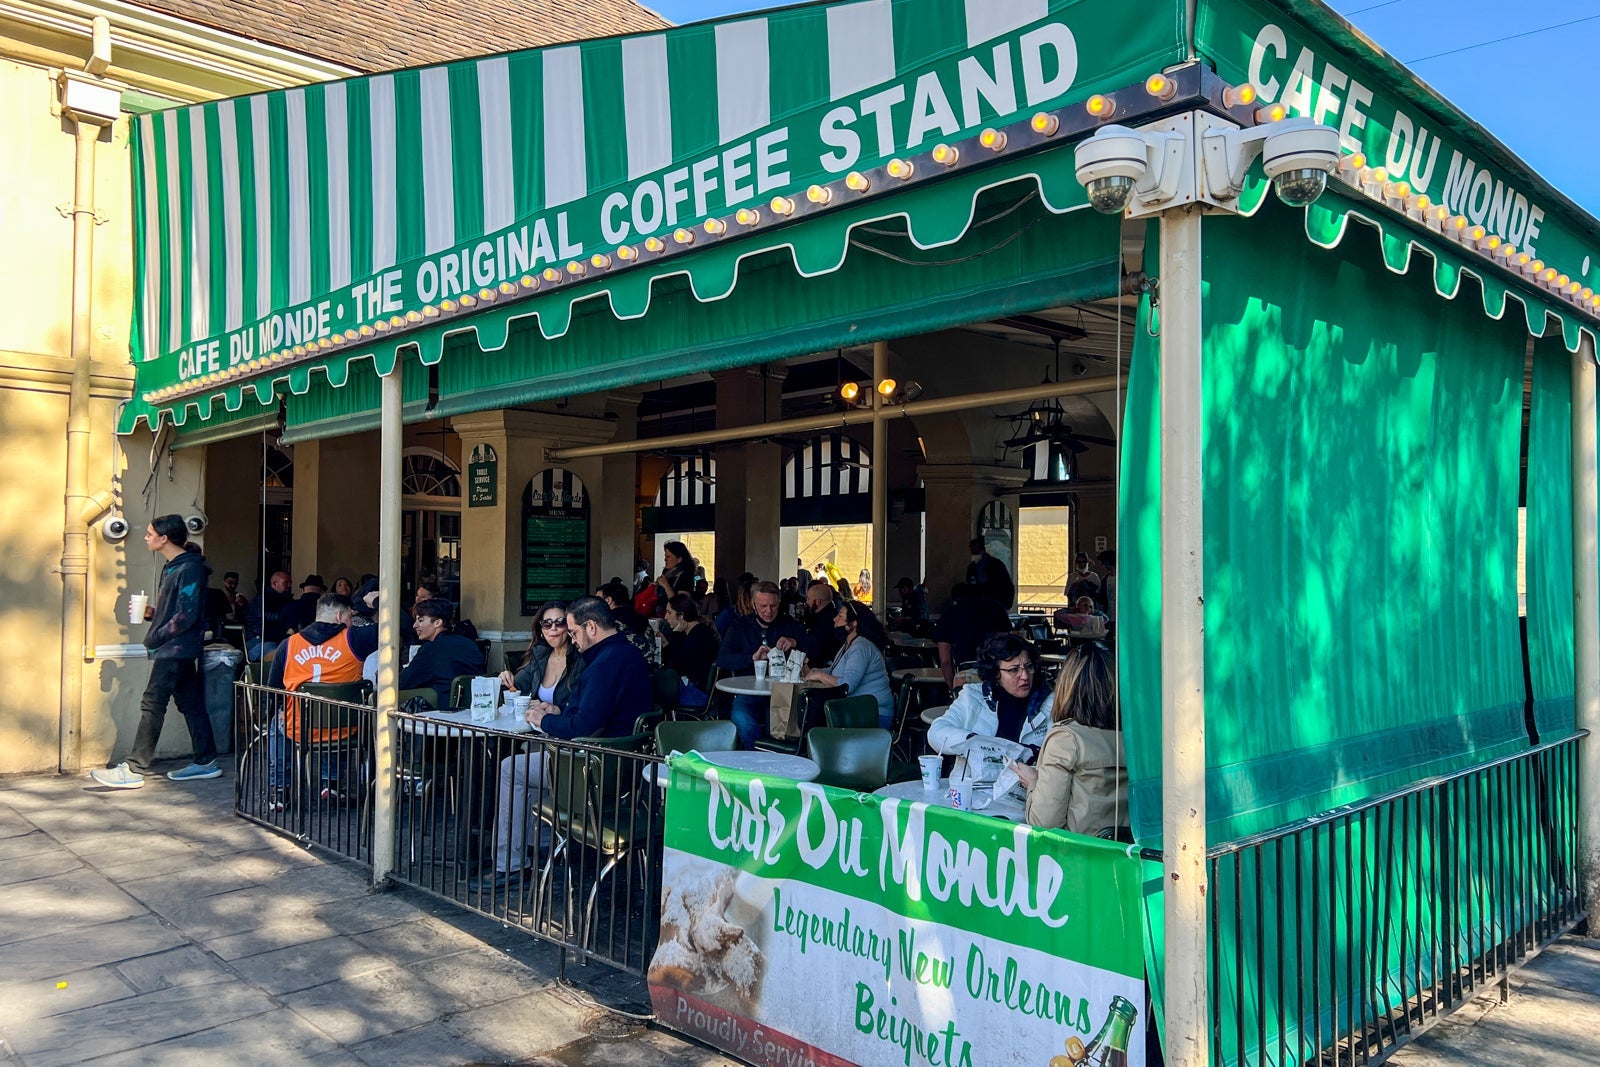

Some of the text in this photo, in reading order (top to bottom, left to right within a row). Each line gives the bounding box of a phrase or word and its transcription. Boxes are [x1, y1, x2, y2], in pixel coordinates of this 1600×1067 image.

[1248, 24, 1546, 258] CAFE DU MONDE
[178, 22, 1079, 381] CAFE DU MONDE THE ORIGINAL COFFEE STAND
[294, 645, 342, 666] BOOKER
[311, 663, 322, 683] 1
[703, 767, 1070, 929] Café Du Monde
[773, 887, 1092, 1036] Legendary New Orleans
[676, 996, 750, 1051] Proudly
[855, 981, 973, 1067] Beignets
